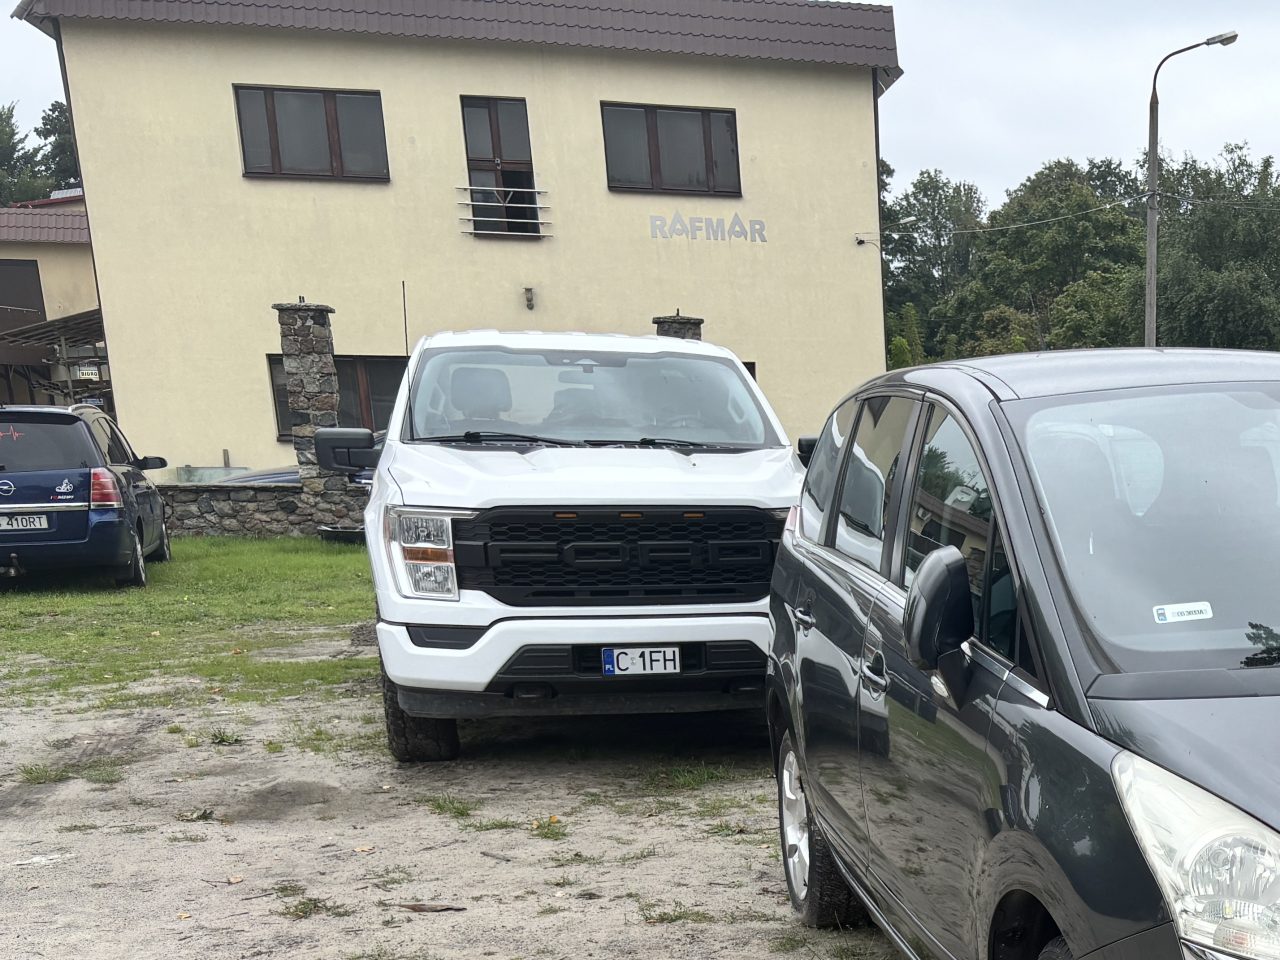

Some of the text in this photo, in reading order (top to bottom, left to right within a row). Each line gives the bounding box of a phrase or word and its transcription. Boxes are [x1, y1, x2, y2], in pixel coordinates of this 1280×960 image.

[649, 210, 768, 243] RAFMAR
[6, 516, 44, 529] 410RT
[616, 650, 677, 672] C 1FH
